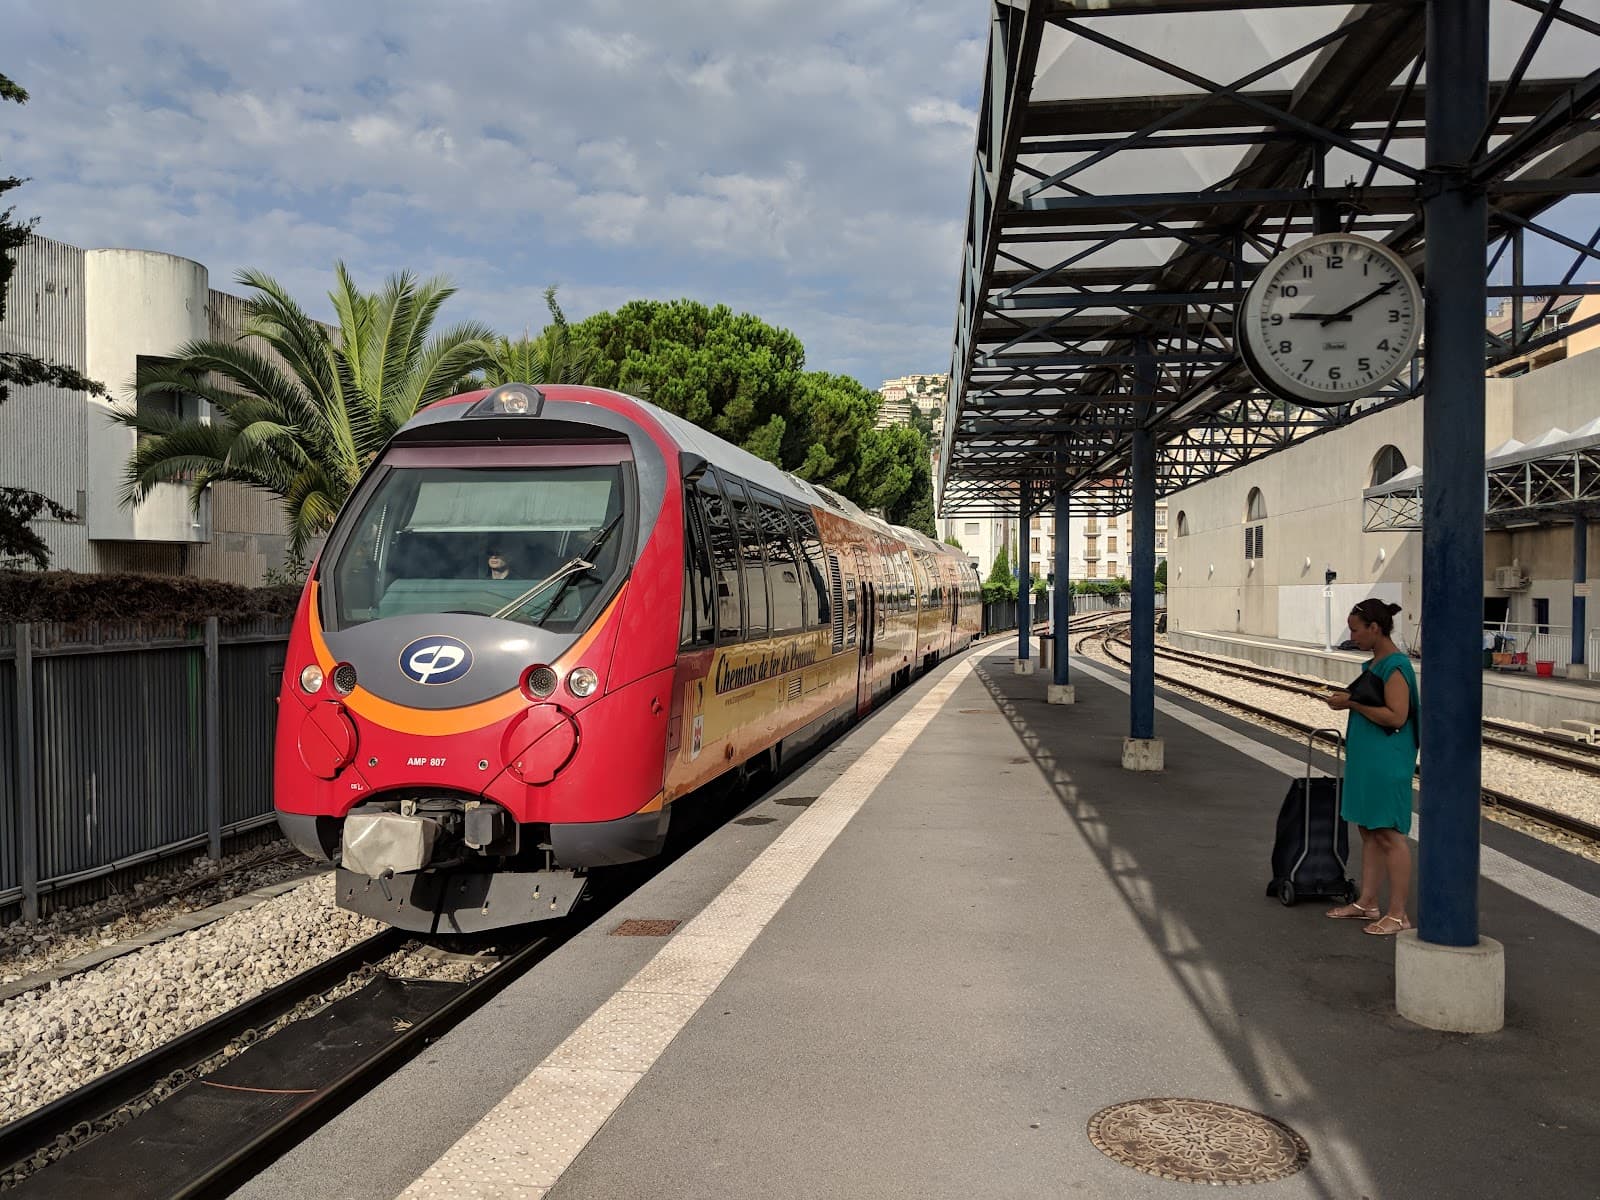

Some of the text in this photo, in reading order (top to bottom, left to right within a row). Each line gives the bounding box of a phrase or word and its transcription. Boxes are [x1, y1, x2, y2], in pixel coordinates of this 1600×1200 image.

[1327, 256, 1343, 269] 12
[1303, 265, 1313, 278] 11
[1364, 263, 1368, 277] 1
[1281, 286, 1298, 298] 10
[1271, 313, 1283, 326] 9
[1388, 310, 1400, 323] 3
[1279, 340, 1292, 354] 8
[1376, 339, 1389, 351] 4
[1302, 359, 1314, 372] 7
[1358, 358, 1370, 371] 5
[1328, 367, 1341, 380] 6
[716, 654, 756, 693] Chemins
[758, 653, 768, 679] de
[770, 651, 780, 676] fer
[781, 649, 789, 672] de
[406, 758, 446, 767] AMP 807
